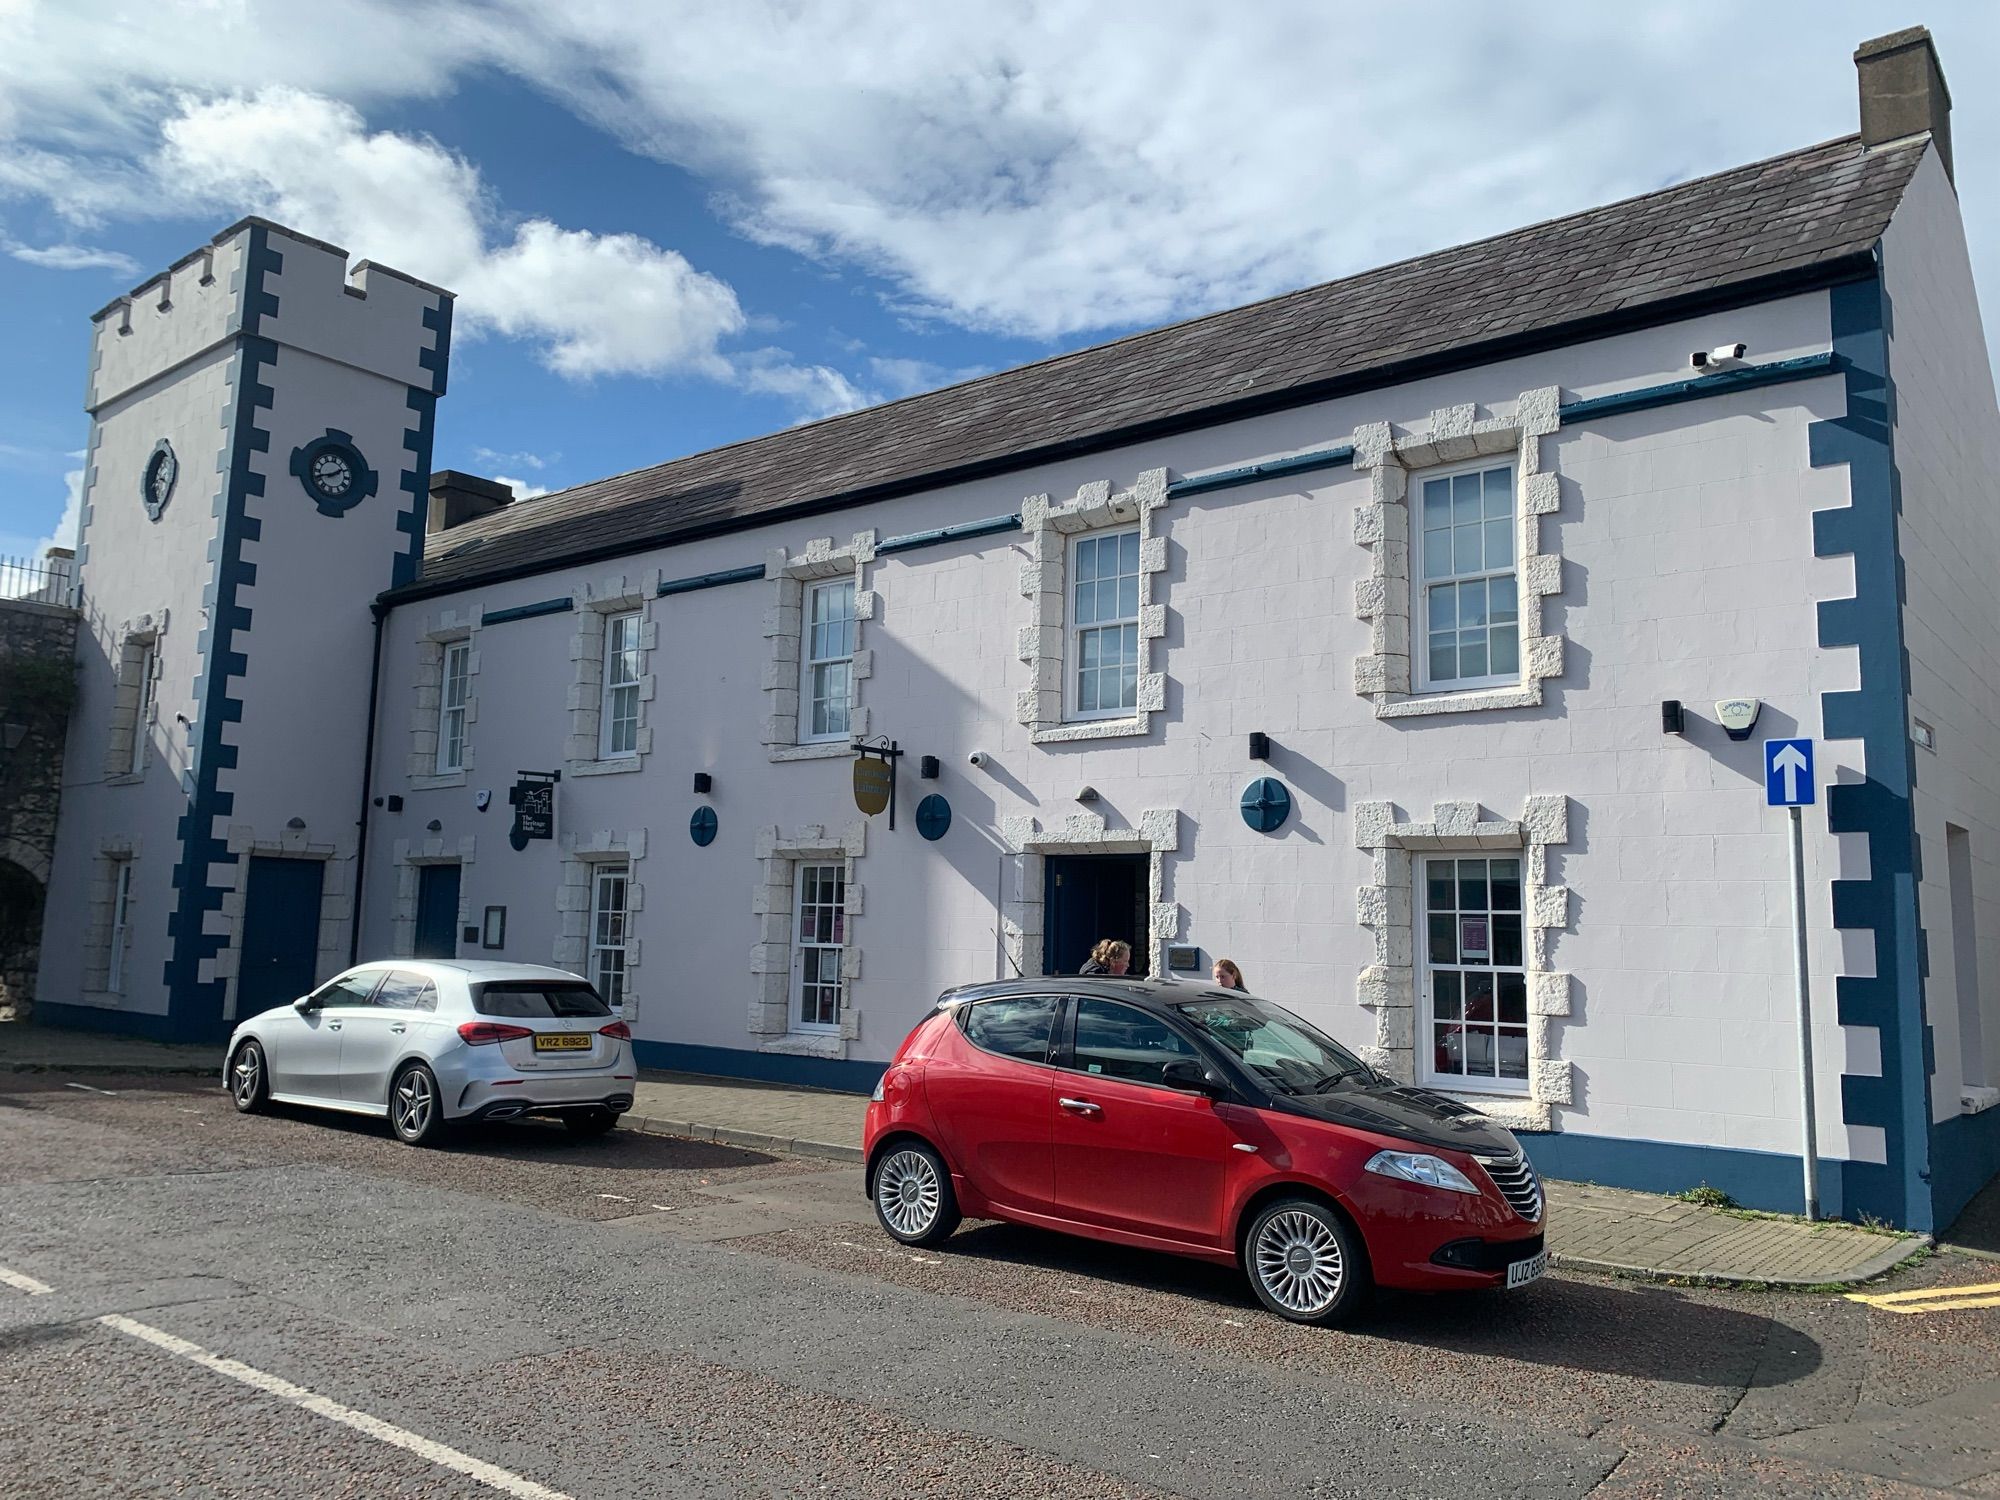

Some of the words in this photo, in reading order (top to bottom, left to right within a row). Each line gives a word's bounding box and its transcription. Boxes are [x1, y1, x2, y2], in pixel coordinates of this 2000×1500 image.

[1722, 701, 1752, 712] LONGMORE
[539, 1037, 560, 1046] VRZ
[562, 1037, 589, 1046] 6923
[1511, 1261, 1530, 1284] UJZ
